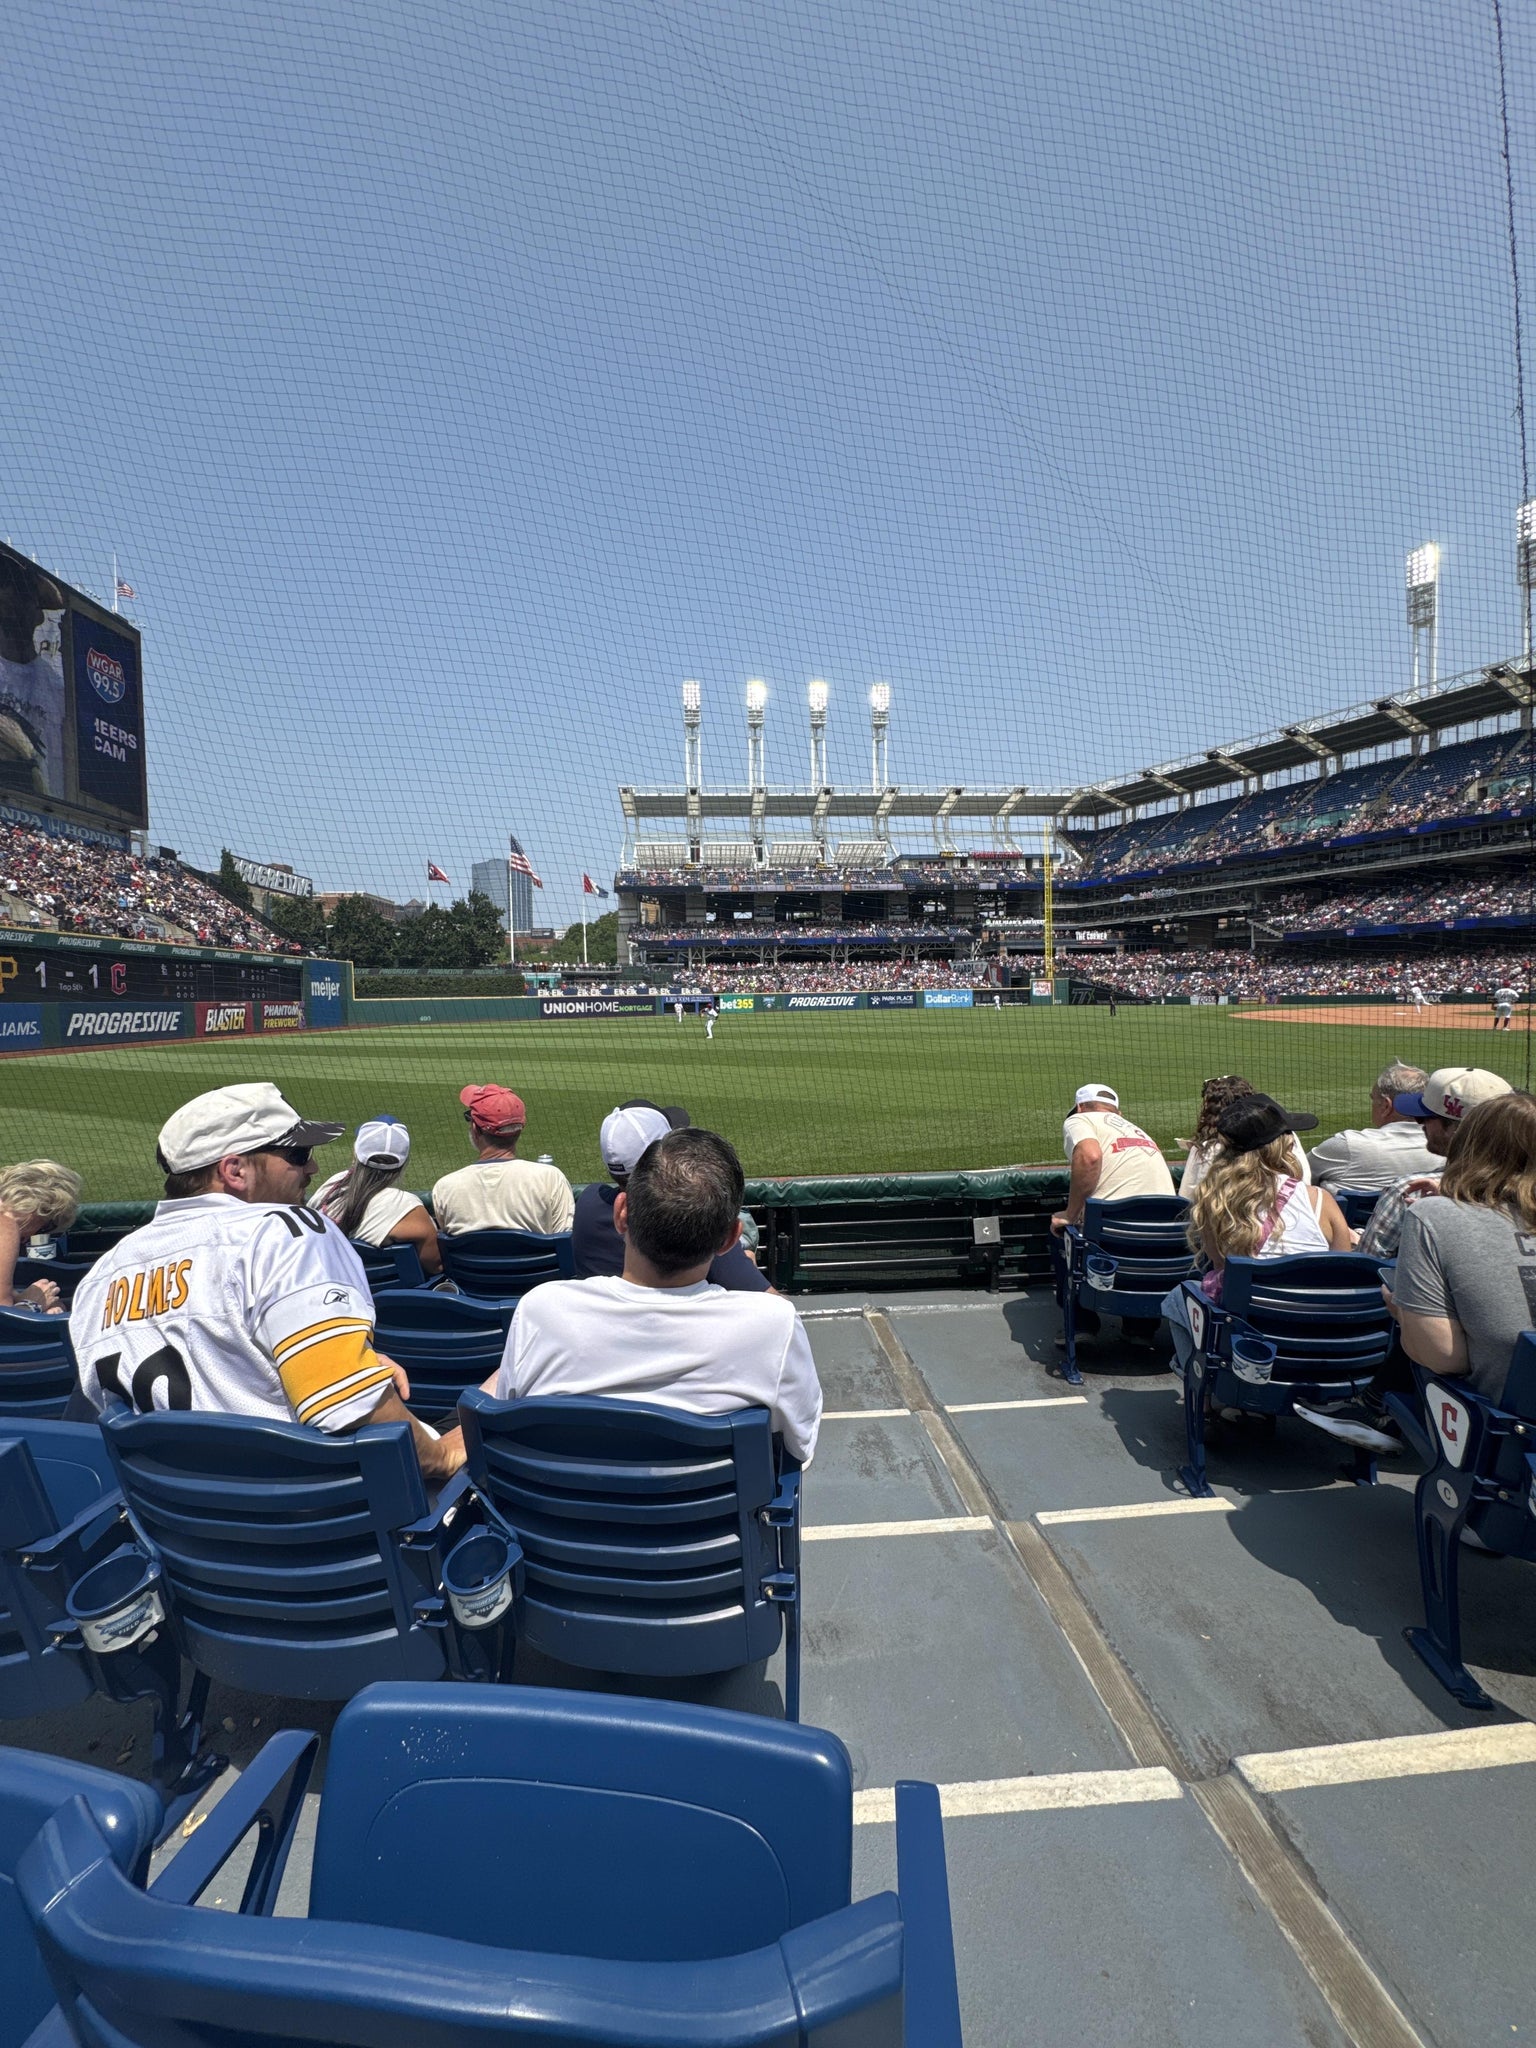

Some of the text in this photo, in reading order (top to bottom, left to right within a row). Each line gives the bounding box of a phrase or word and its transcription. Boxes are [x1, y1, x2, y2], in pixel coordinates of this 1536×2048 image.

[90, 653, 122, 680] WGAR
[93, 672, 120, 698] 99.5
[94, 735, 126, 762] CAM
[65, 823, 123, 847] HONDA
[57, 936, 102, 949] PROGRESSIVE
[35, 961, 46, 988] 1
[88, 963, 98, 989] 1
[311, 977, 340, 1000] meijer
[264, 1004, 299, 1016] PHANTOM
[720, 999, 754, 1009] bet365
[788, 996, 856, 1007] PROGRESSIVE
[0, 1021, 40, 1036] IAMS.
[66, 1012, 183, 1037] PROGRESSIVE
[204, 1007, 246, 1032] BLASTER
[263, 1206, 326, 1238] 10
[101, 1258, 193, 1332] HOLMES
[1441, 1402, 1458, 1442] C
[118, 1620, 140, 1635] FIELD
